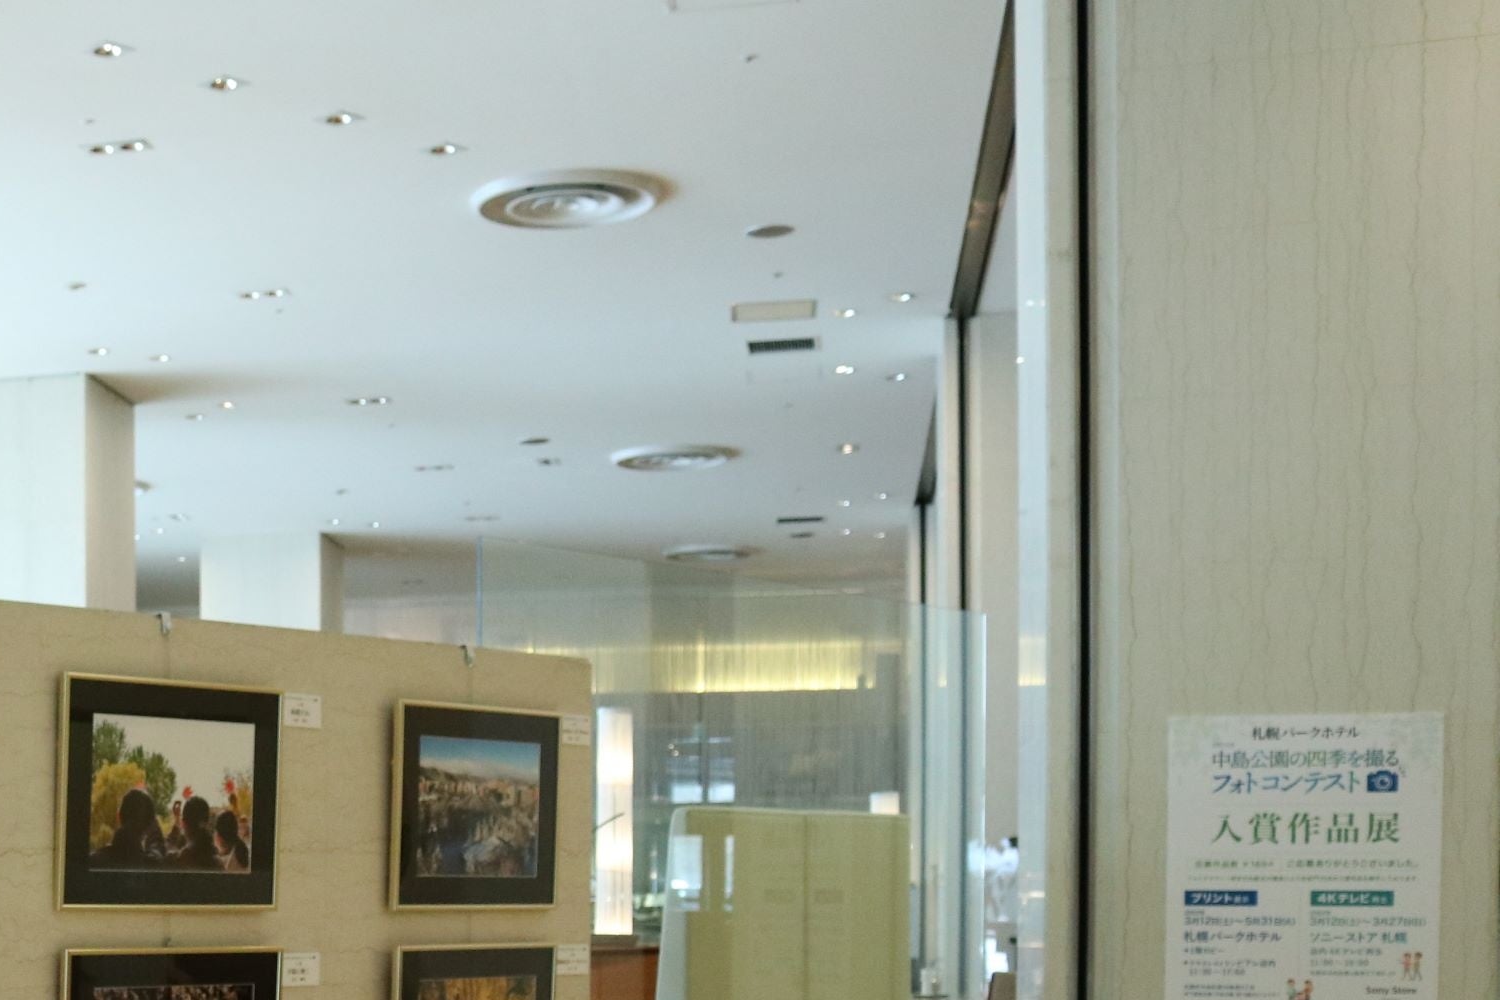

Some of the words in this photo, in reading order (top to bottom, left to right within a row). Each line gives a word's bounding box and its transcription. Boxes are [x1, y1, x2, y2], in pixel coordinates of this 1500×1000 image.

[1252, 726, 1360, 741] 札幌パークホテル
[1212, 749, 1400, 769] 中島公園の四季を撮る
[1212, 771, 1361, 794] フォトコンテスト
[1211, 812, 1401, 844] 入賞作品展
